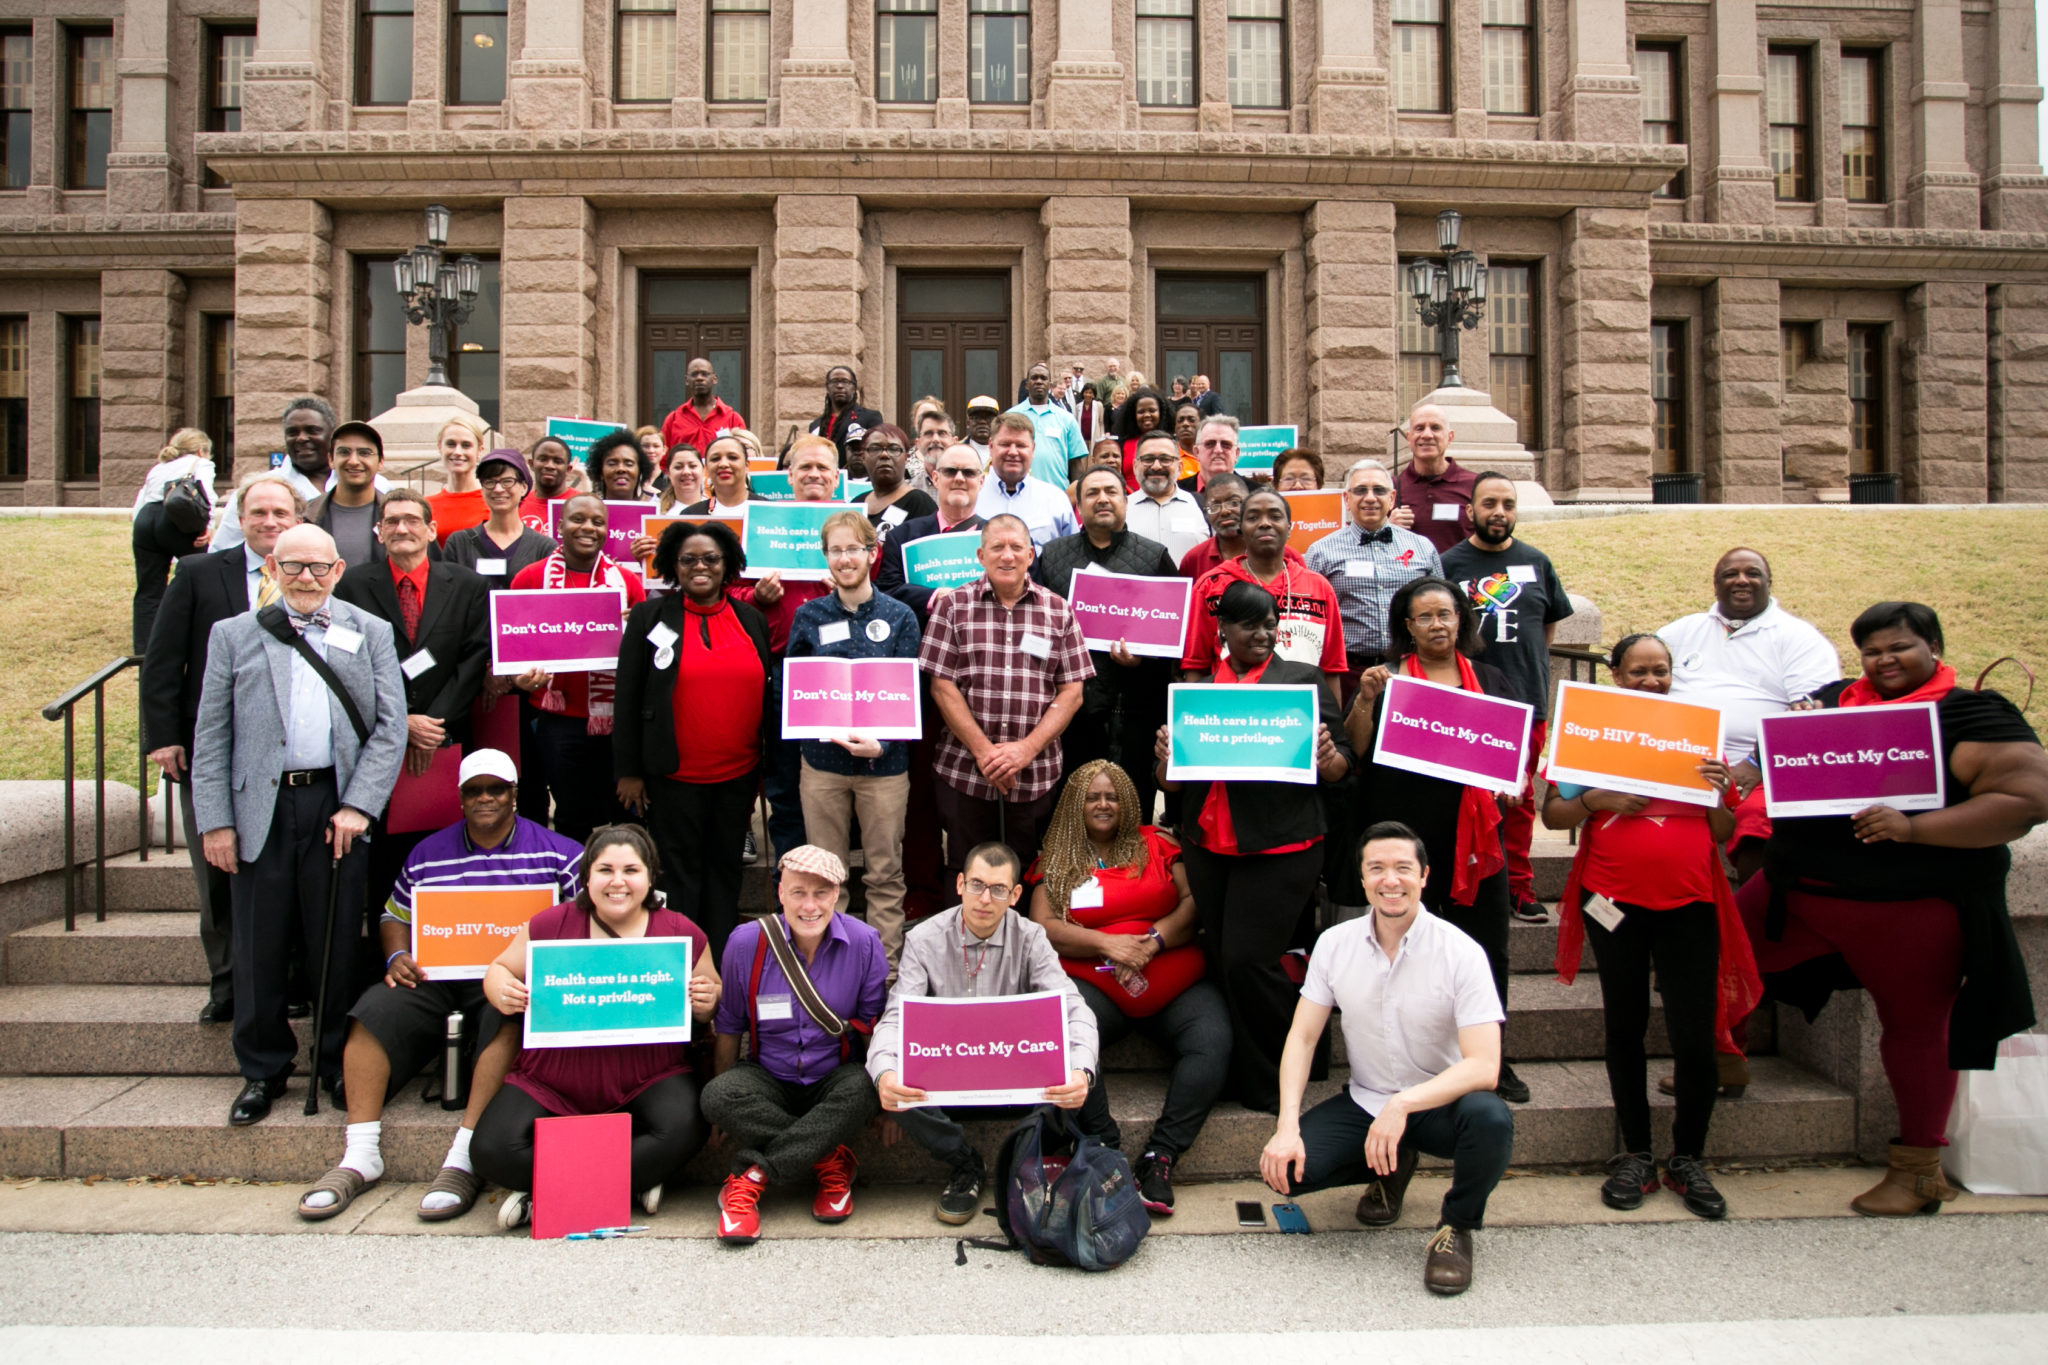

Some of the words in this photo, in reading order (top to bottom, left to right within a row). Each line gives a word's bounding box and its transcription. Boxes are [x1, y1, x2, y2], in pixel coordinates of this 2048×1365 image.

[1252, 450, 1279, 458] privilege
[757, 526, 788, 536] Health
[789, 528, 810, 536] care
[811, 526, 818, 536] is
[1296, 519, 1339, 532] Together.
[610, 529, 626, 540] My
[770, 541, 788, 549] Not
[789, 542, 794, 550] a
[796, 541, 822, 552] privil
[914, 558, 941, 573] Health
[942, 557, 962, 566] care
[964, 556, 972, 564] is
[926, 572, 942, 582] Not
[1076, 600, 1107, 614] Don't
[1108, 605, 1130, 616] Cut
[1131, 606, 1150, 620] My
[1150, 609, 1180, 620] Care.
[502, 622, 536, 635] Don't
[538, 622, 562, 634] Cut
[564, 622, 584, 634] My
[586, 621, 618, 632] Care.
[792, 689, 828, 700] Don't
[830, 690, 854, 702] Cut
[855, 690, 875, 702] My
[878, 690, 910, 701] Care.
[1184, 714, 1220, 726] Health
[1222, 716, 1247, 726] care
[1248, 716, 1258, 726] is
[1260, 718, 1268, 726] a
[1270, 716, 1302, 728] right.
[1391, 711, 1428, 730] Don't
[1430, 720, 1456, 737] Cut
[1457, 726, 1480, 744] My
[1481, 733, 1517, 752] Care.
[1200, 732, 1220, 743] Not
[1222, 734, 1230, 743] a
[1231, 732, 1284, 746] privilege.
[1564, 722, 1600, 740] Stop
[1602, 727, 1636, 744] HIV
[1638, 732, 1713, 756] Together.
[1773, 752, 1820, 768] Don't
[1822, 751, 1854, 764] Cut
[1856, 749, 1884, 765] My
[1886, 748, 1930, 761] Care.
[422, 924, 454, 938] Stop
[455, 923, 483, 936] HIV
[485, 922, 527, 938] Toget
[544, 972, 586, 987] Health
[588, 974, 616, 985] care
[617, 973, 628, 984] is
[630, 974, 638, 984] a
[640, 970, 674, 986] right.
[562, 993, 586, 1006] Not
[588, 994, 596, 1004] a
[598, 990, 656, 1006] privilege.
[909, 1042, 952, 1058] Don't
[956, 1042, 986, 1056] Cut
[989, 1042, 1014, 1058] My
[1017, 1040, 1059, 1054] Care.
